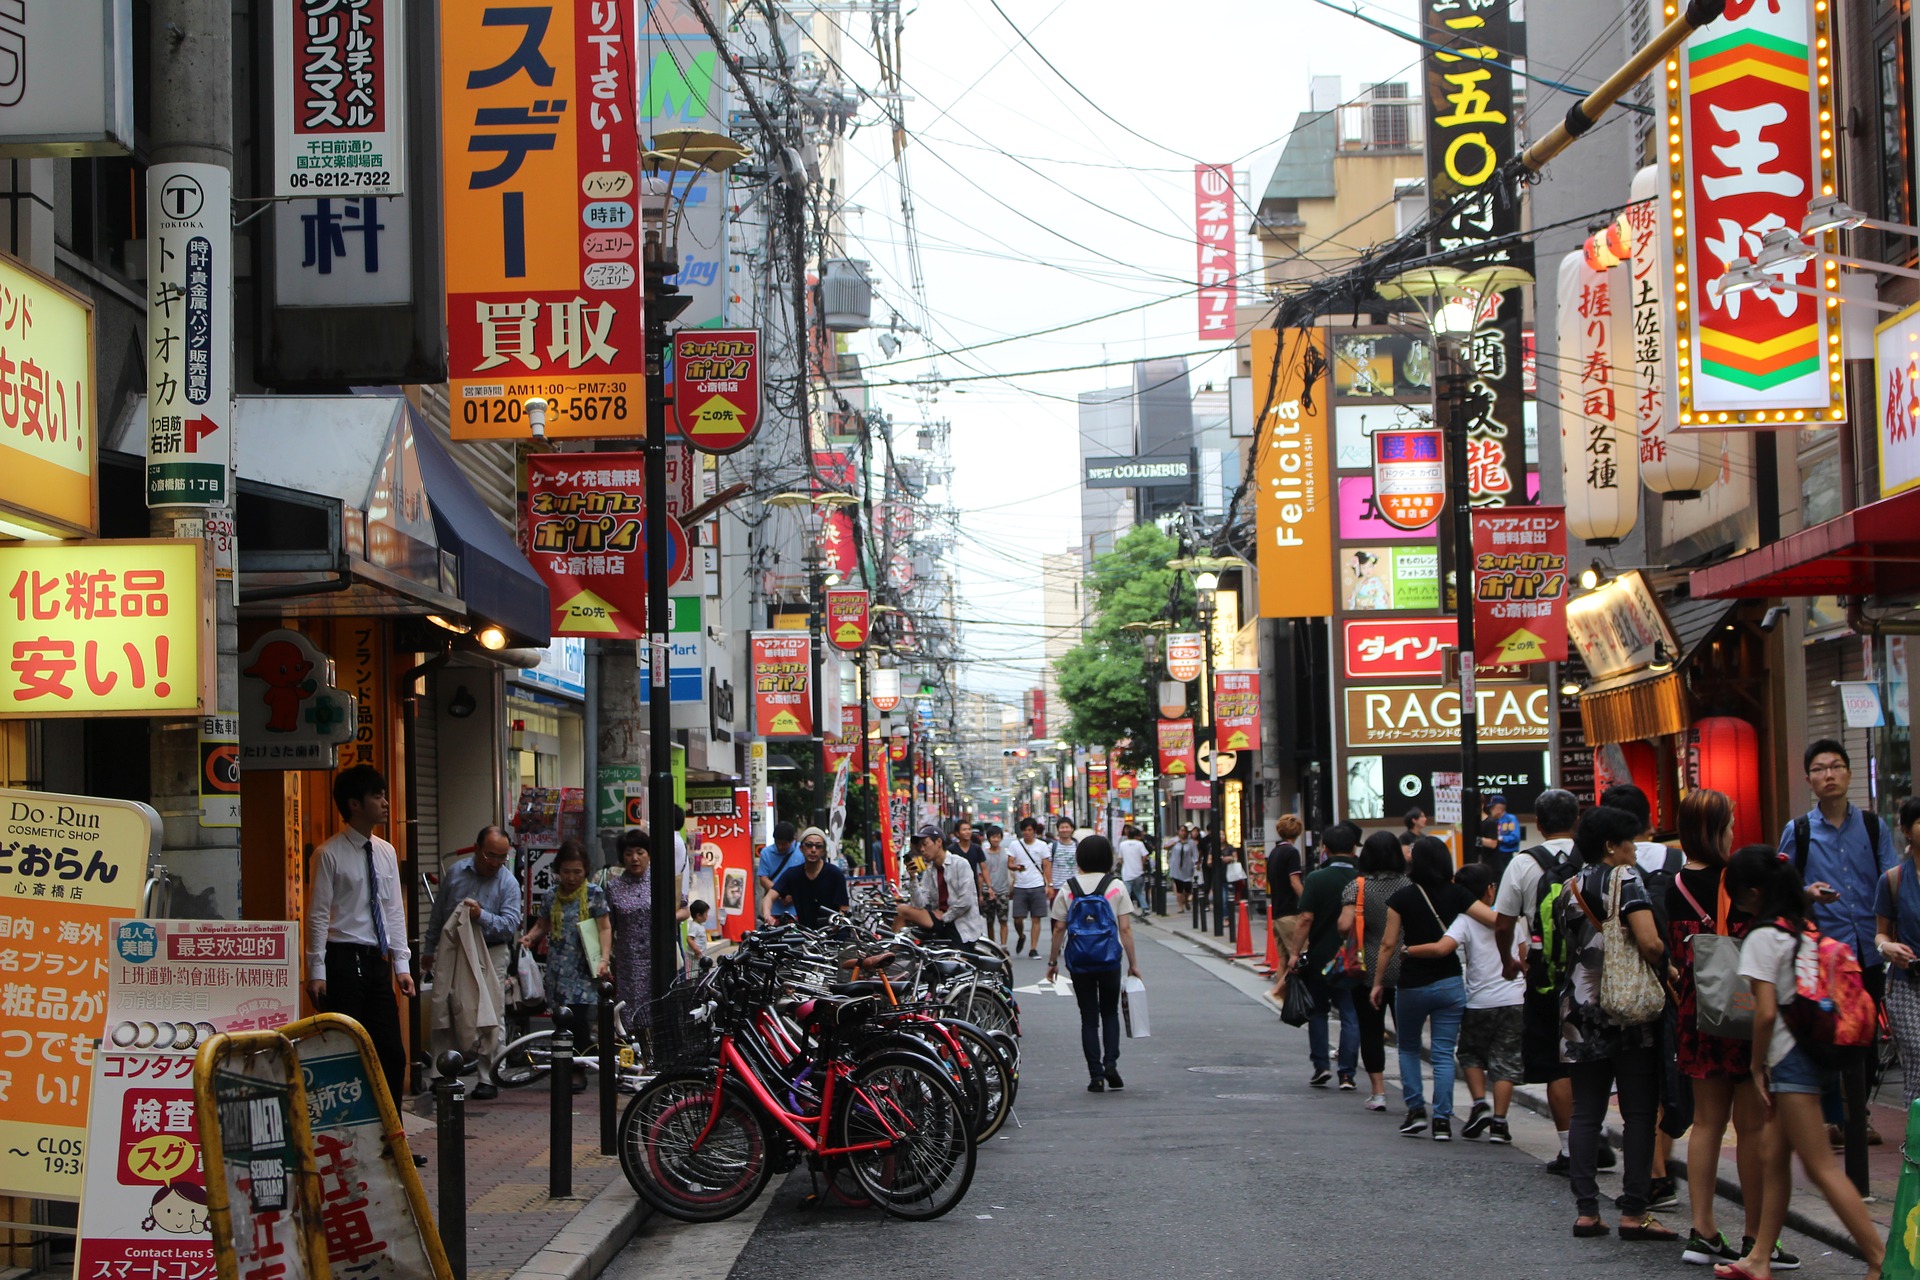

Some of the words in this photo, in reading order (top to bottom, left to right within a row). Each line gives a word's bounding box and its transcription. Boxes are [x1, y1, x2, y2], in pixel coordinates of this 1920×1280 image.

[307, 140, 373, 154] 千日前通り
[296, 154, 383, 169] 国立文楽劇場西
[290, 172, 390, 188] 06-6212-7322
[587, 175, 628, 192] バッグ
[590, 205, 626, 223] 時計
[301, 198, 385, 274] 科
[586, 238, 633, 253] ジュエリー
[586, 265, 629, 276] ノーブランド
[1200, 200, 1229, 330] ネットカフェ
[590, 276, 630, 287] ジュエリー
[190, 240, 209, 348] 時計・貴金属・バッグ
[0, 284, 33, 341] ンド
[154, 236, 182, 407] トキオカ
[473, 296, 619, 372] 買取
[679, 341, 755, 358] ネットカフェ
[189, 350, 208, 401] 販売買取
[684, 359, 750, 382] ポパイ
[463, 384, 504, 398] 営業時間
[697, 381, 738, 393] 心斎橋店
[463, 395, 628, 425] 0120-3-5678
[702, 410, 733, 421] この先
[151, 433, 182, 454] 右折
[1382, 435, 1438, 459] 腰痛
[531, 469, 640, 487] ケータイ充電無料
[1089, 468, 1113, 479] NEW
[1113, 463, 1188, 479] COLUMBUS
[1306, 433, 1315, 513] SHINSAIBASHI
[151, 479, 186, 492] 心斎橋筋
[189, 478, 219, 491] 1丁目
[532, 491, 641, 515] ネットカフェ
[1478, 517, 1560, 530] ヘアアイロン
[532, 516, 643, 554] ポパイ
[1492, 531, 1547, 545] 無料貸出
[550, 556, 625, 576] 心斎橋店
[1478, 553, 1566, 571] ネットカフェ
[9, 569, 169, 621] 化粧品
[1479, 573, 1566, 602] ポパイ
[571, 606, 606, 619] この先
[1491, 602, 1552, 618] 心斎橋店
[756, 640, 806, 648] ヘアアイロン
[1357, 635, 1452, 662] ダイソー
[1508, 640, 1535, 651] この先
[11, 635, 170, 700] 安い!
[756, 663, 808, 674] ネットカフェ
[757, 676, 807, 692] ポパイ
[354, 629, 374, 772] ブランド品の買
[1365, 689, 1549, 729] RAGTAG
[597, 769, 639, 779] スクール・ゾーン
[8, 824, 65, 839] COSMETIC
[68, 829, 100, 842] SHOP
[0, 841, 119, 884] どおらん
[14, 881, 84, 900] 心斎橋店
[0, 915, 103, 947] 国内・海外
[119, 927, 155, 939] 超人气
[121, 940, 154, 957] 美瞳
[176, 937, 276, 957] 最受欢迎的
[0, 948, 109, 979] 名ブランド
[132, 1098, 195, 1132] 検査
[136, 1141, 187, 1174] スグ
[125, 1247, 171, 1258] Contact
[175, 1248, 204, 1259] Lens
